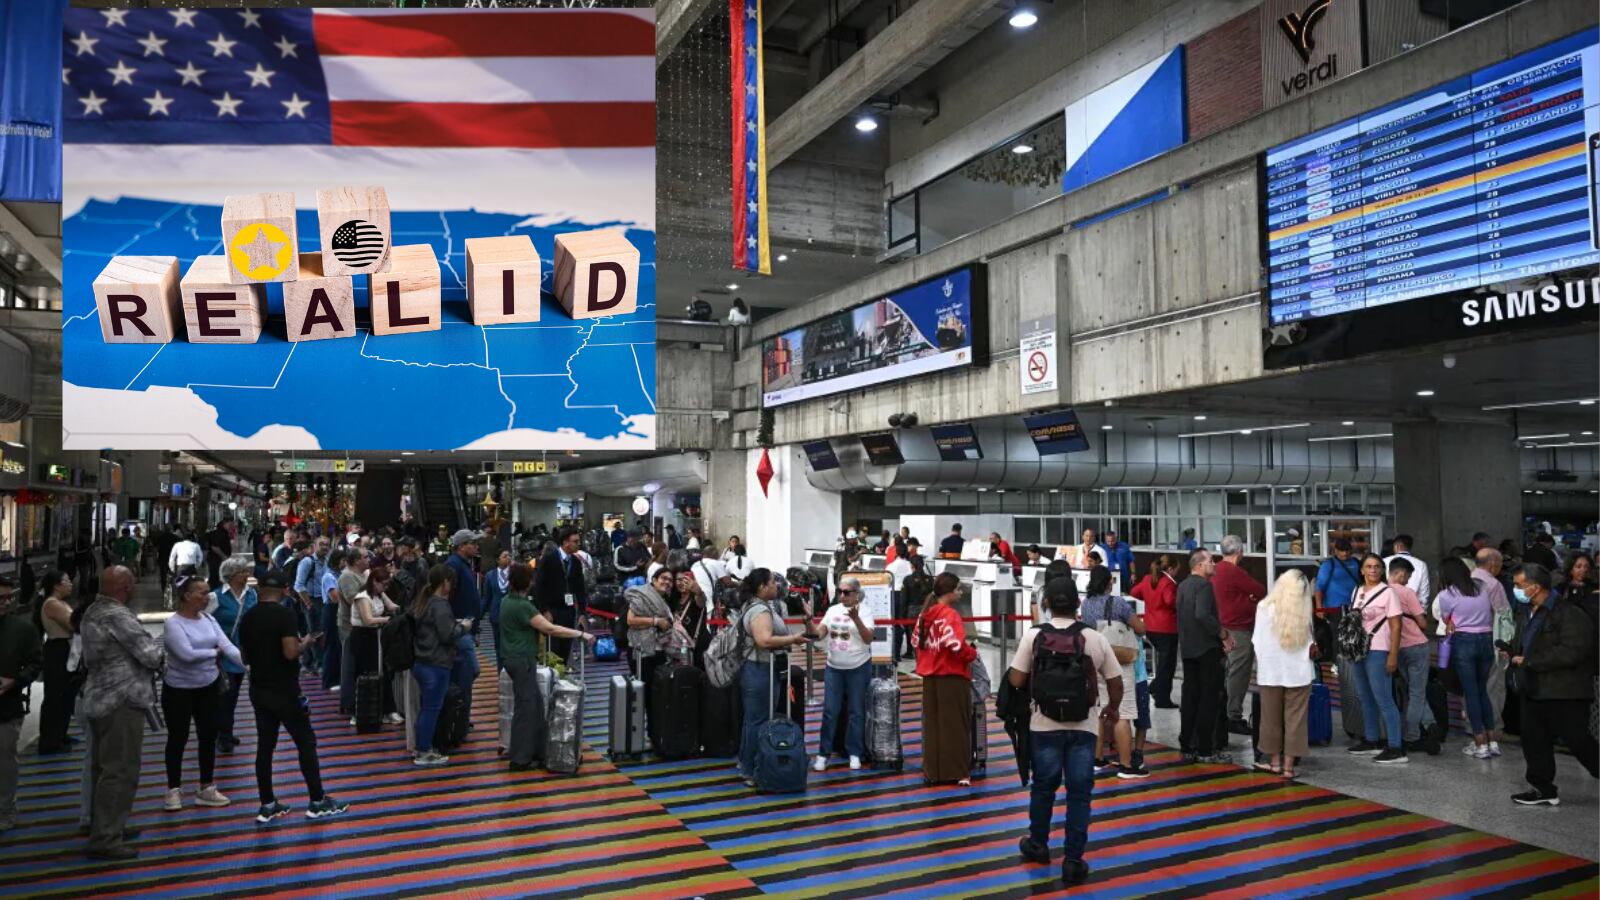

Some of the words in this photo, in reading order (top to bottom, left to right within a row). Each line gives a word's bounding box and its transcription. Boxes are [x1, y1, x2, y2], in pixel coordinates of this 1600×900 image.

[1281, 54, 1337, 97] verdi
[1522, 69, 1558, 86] Remark
[1366, 110, 1428, 136] PROCEDENCIA
[1371, 130, 1408, 146] BOGOTA
[1452, 105, 1477, 118] 11:02
[1501, 103, 1578, 133] CHEQUEANDO
[1372, 148, 1411, 164] PANAMA
[1373, 167, 1411, 182] PANAMA
[1374, 190, 1395, 200] VIRU
[1396, 184, 1417, 194] VIRU
[1375, 213, 1417, 228] CURAZAO
[1376, 232, 1419, 247] CURAZAO
[1377, 251, 1414, 265] PANAMA
[1377, 271, 1415, 284] PANAMA
[1519, 263, 1546, 276] The
[107, 278, 430, 338] REAL
[502, 261, 627, 316] ID
